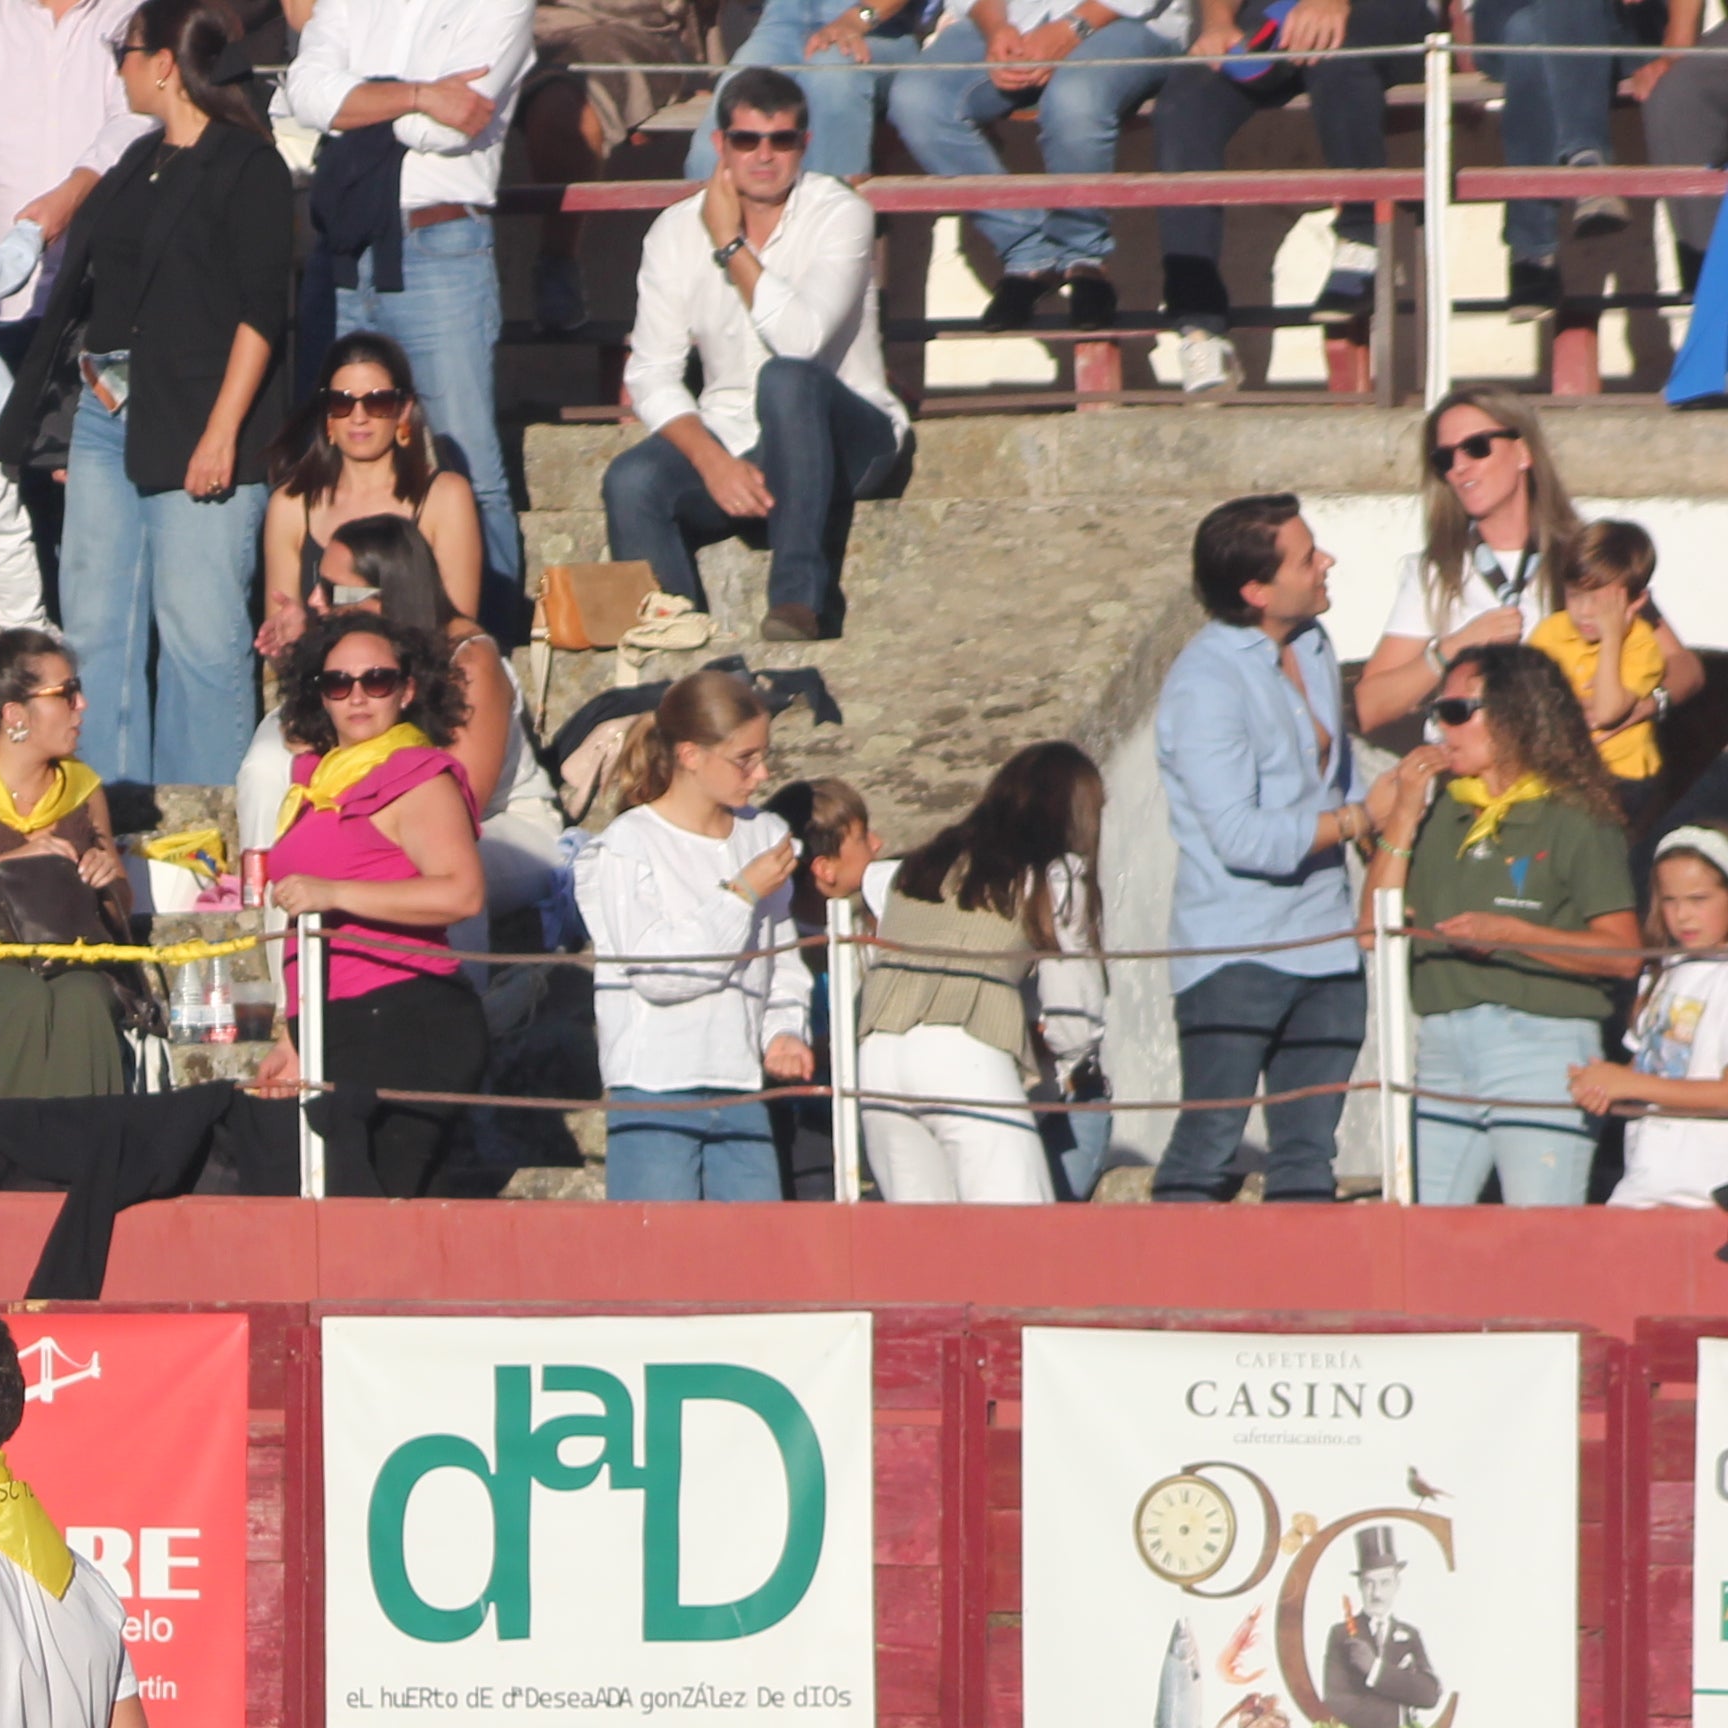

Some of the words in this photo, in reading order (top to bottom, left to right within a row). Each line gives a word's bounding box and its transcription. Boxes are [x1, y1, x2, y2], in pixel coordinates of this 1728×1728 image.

[1235, 1350, 1363, 1370] CAFETERÍA
[1185, 1380, 1414, 1420] CASINO
[1233, 1427, 1363, 1446] cafeteriacasino.es
[465, 1685, 494, 1709] dE
[757, 1686, 786, 1709] De
